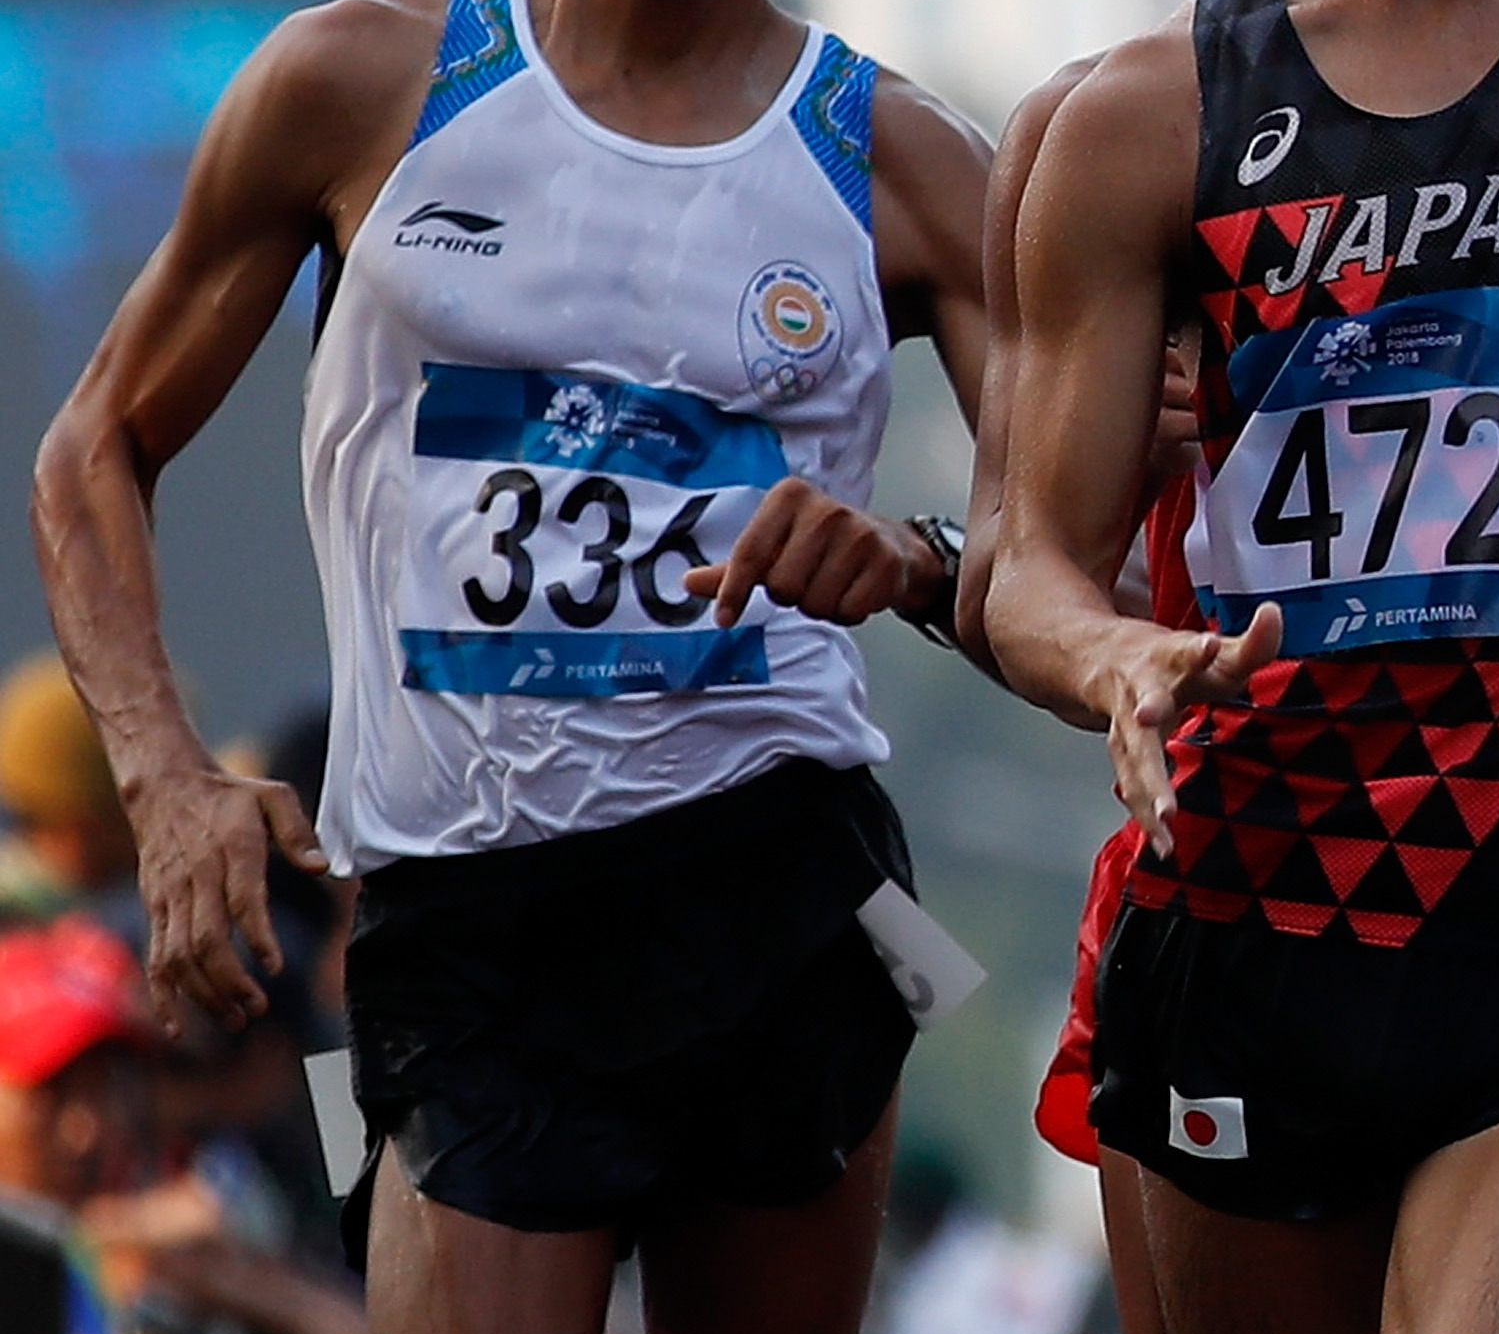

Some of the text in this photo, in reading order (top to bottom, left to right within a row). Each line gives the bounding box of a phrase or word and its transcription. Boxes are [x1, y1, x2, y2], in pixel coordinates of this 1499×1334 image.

[394, 231, 503, 256] LI-NING
[1387, 351, 1420, 366] 2018
[462, 469, 716, 630] 336
[1375, 604, 1477, 627] PERTAMINA
[565, 660, 665, 679] PERTAMINA
